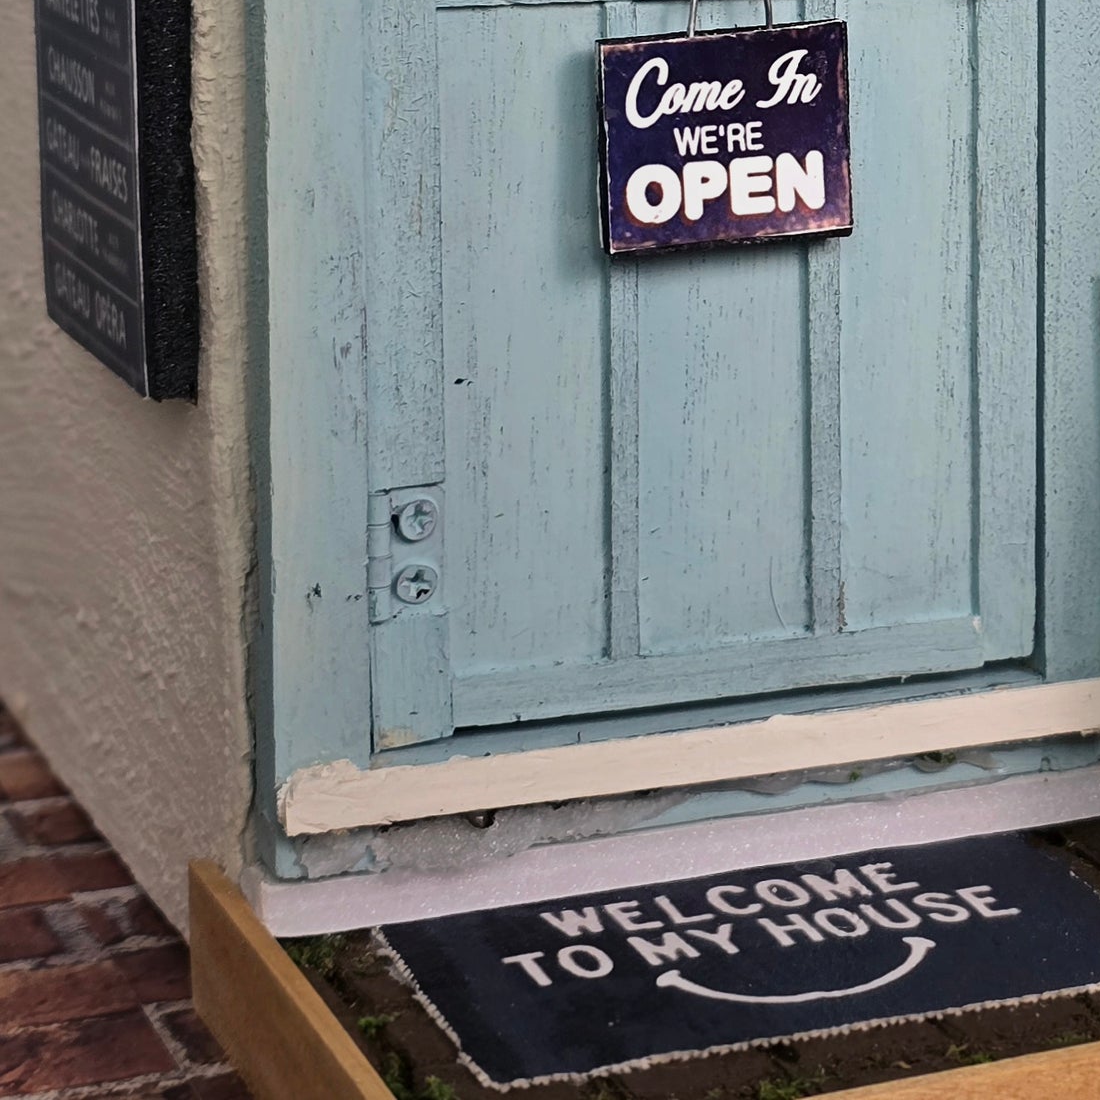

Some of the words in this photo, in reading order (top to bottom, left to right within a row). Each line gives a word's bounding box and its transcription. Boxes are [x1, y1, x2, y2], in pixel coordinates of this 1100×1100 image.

[47, 44, 96, 109] CHAUSSON
[625, 57, 745, 129] Come
[756, 49, 822, 109] In
[90, 145, 128, 204] FRAISES
[673, 121, 764, 156] WE'RE
[626, 150, 826, 225] OPEN
[502, 944, 614, 988] TO
[627, 922, 740, 968] MY
[755, 885, 1022, 947] HOUSE
[540, 861, 920, 938] WELCOME
